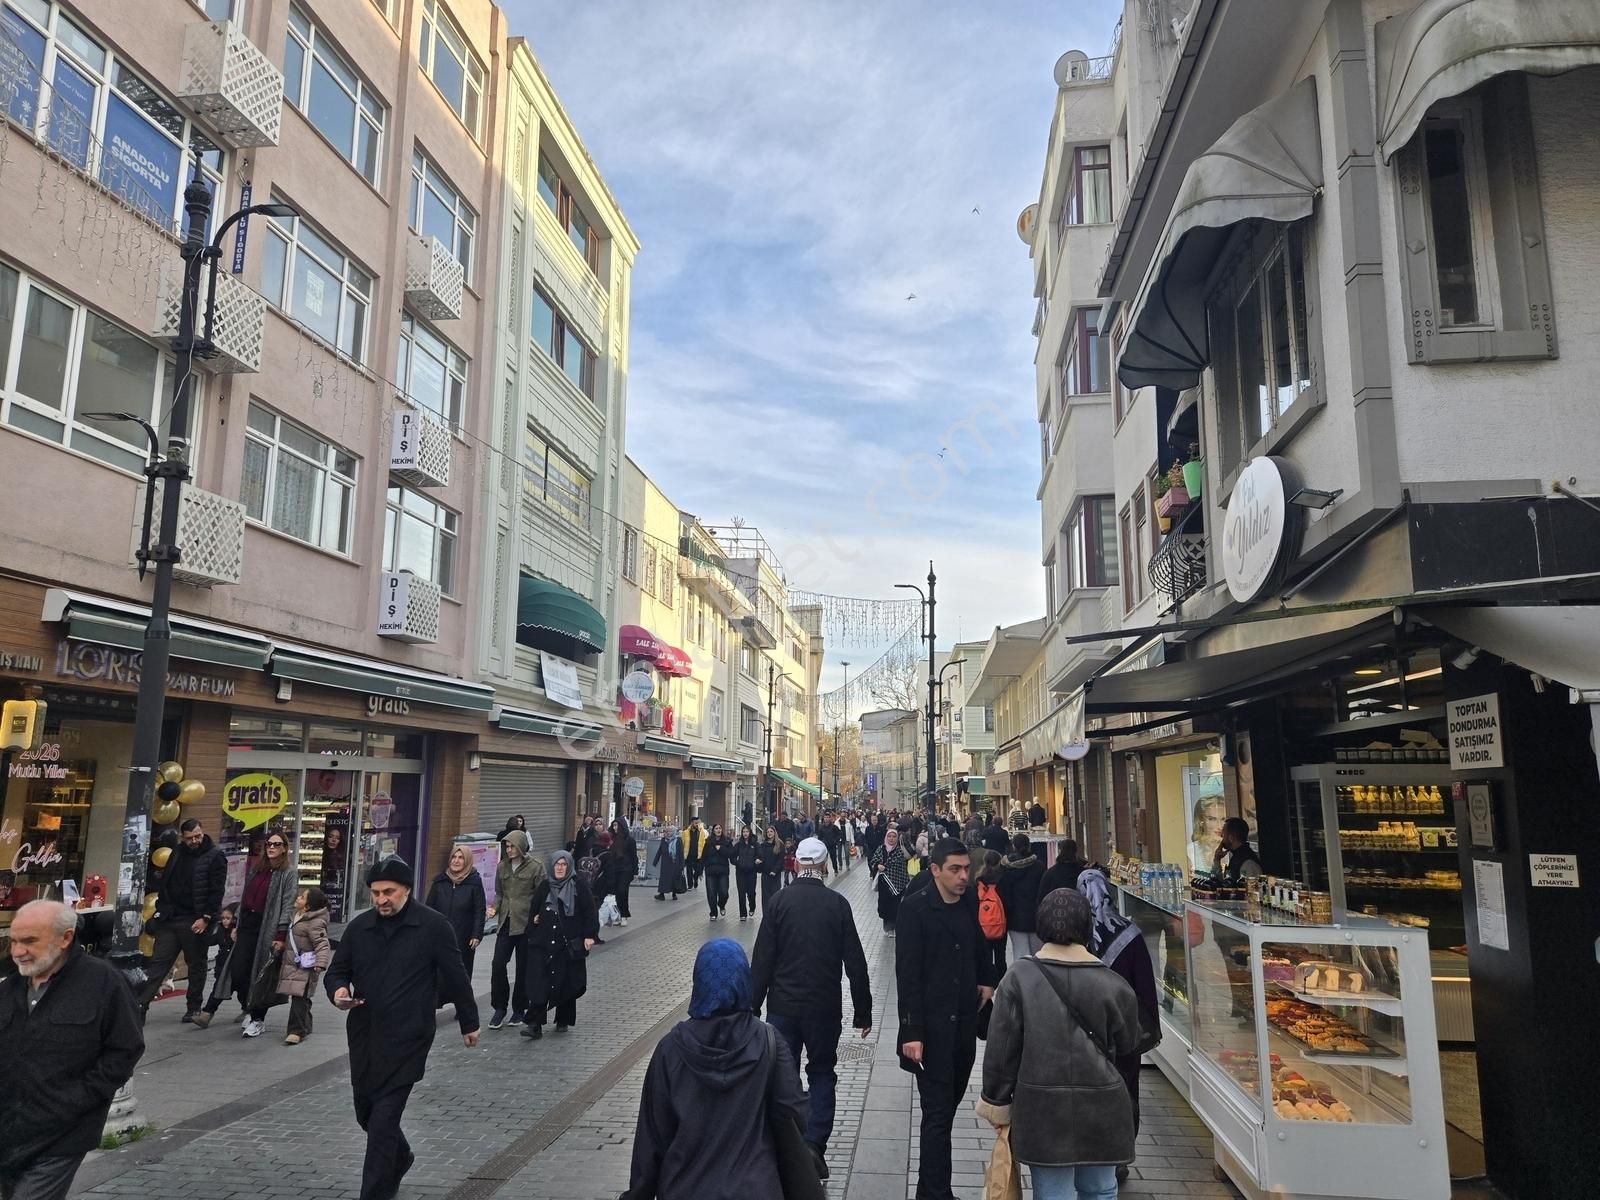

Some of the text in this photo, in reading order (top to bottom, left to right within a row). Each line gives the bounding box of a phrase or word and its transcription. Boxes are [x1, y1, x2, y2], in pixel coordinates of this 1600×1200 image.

[111, 145, 162, 191] SİGORTA
[112, 135, 170, 184] ANADOLU
[240, 190, 250, 227] ANALU
[400, 414, 410, 452] DİŞ
[391, 456, 415, 465] HEKİMİ
[387, 577, 399, 618] DİŞ
[379, 621, 403, 631] HEKİMİ
[14, 655, 44, 672] HANI
[1455, 701, 1487, 717] TOPTAN
[1450, 716, 1497, 733] DONDURMA
[1455, 733, 1494, 749] SATIŞIMIZ
[1459, 750, 1492, 763] VARDIR.
[8, 762, 41, 779] Mutlu
[227, 780, 282, 813] gratis
[1533, 863, 1575, 871] ÇÖPLERİNİZİ
